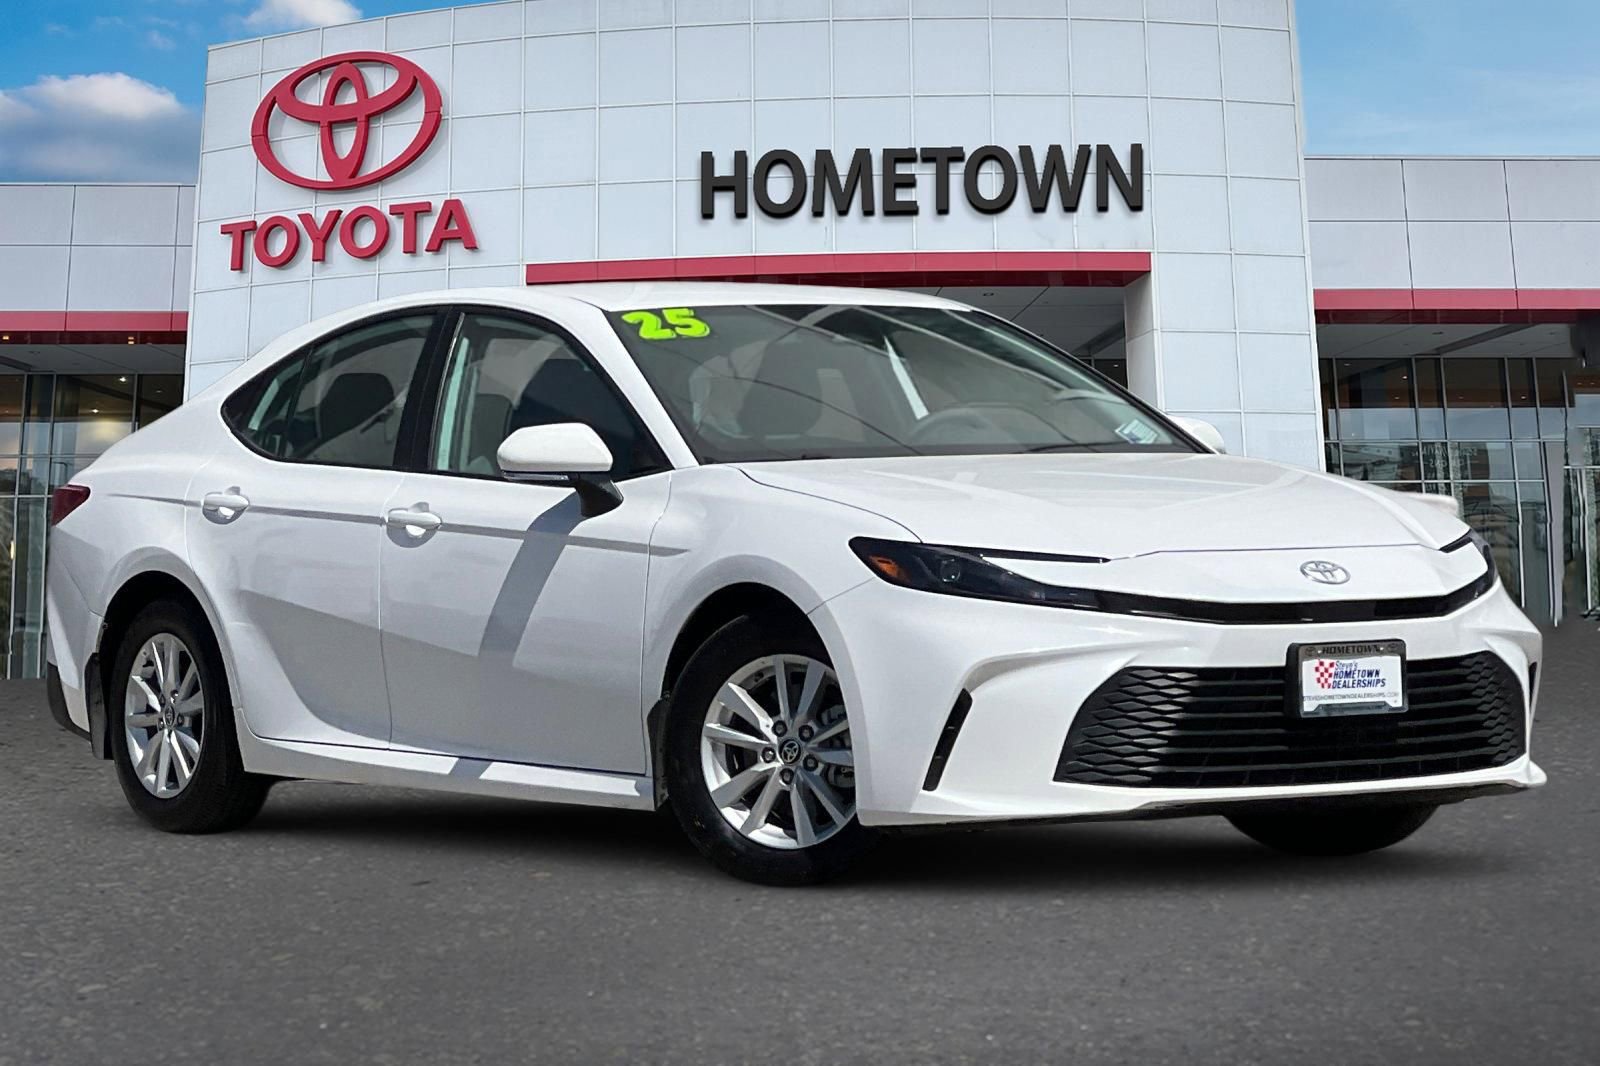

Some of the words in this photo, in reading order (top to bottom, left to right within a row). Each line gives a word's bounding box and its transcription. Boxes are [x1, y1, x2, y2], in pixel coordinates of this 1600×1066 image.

[700, 143, 1144, 219] HOMETOWN
[220, 198, 479, 271] TOYOTA
[621, 307, 710, 340] 25
[1322, 644, 1380, 655] HOMETOWN
[1335, 660, 1358, 671] Steve's
[1333, 669, 1380, 680] HOMETOWN
[1332, 678, 1386, 690] DEALERSHIPS
